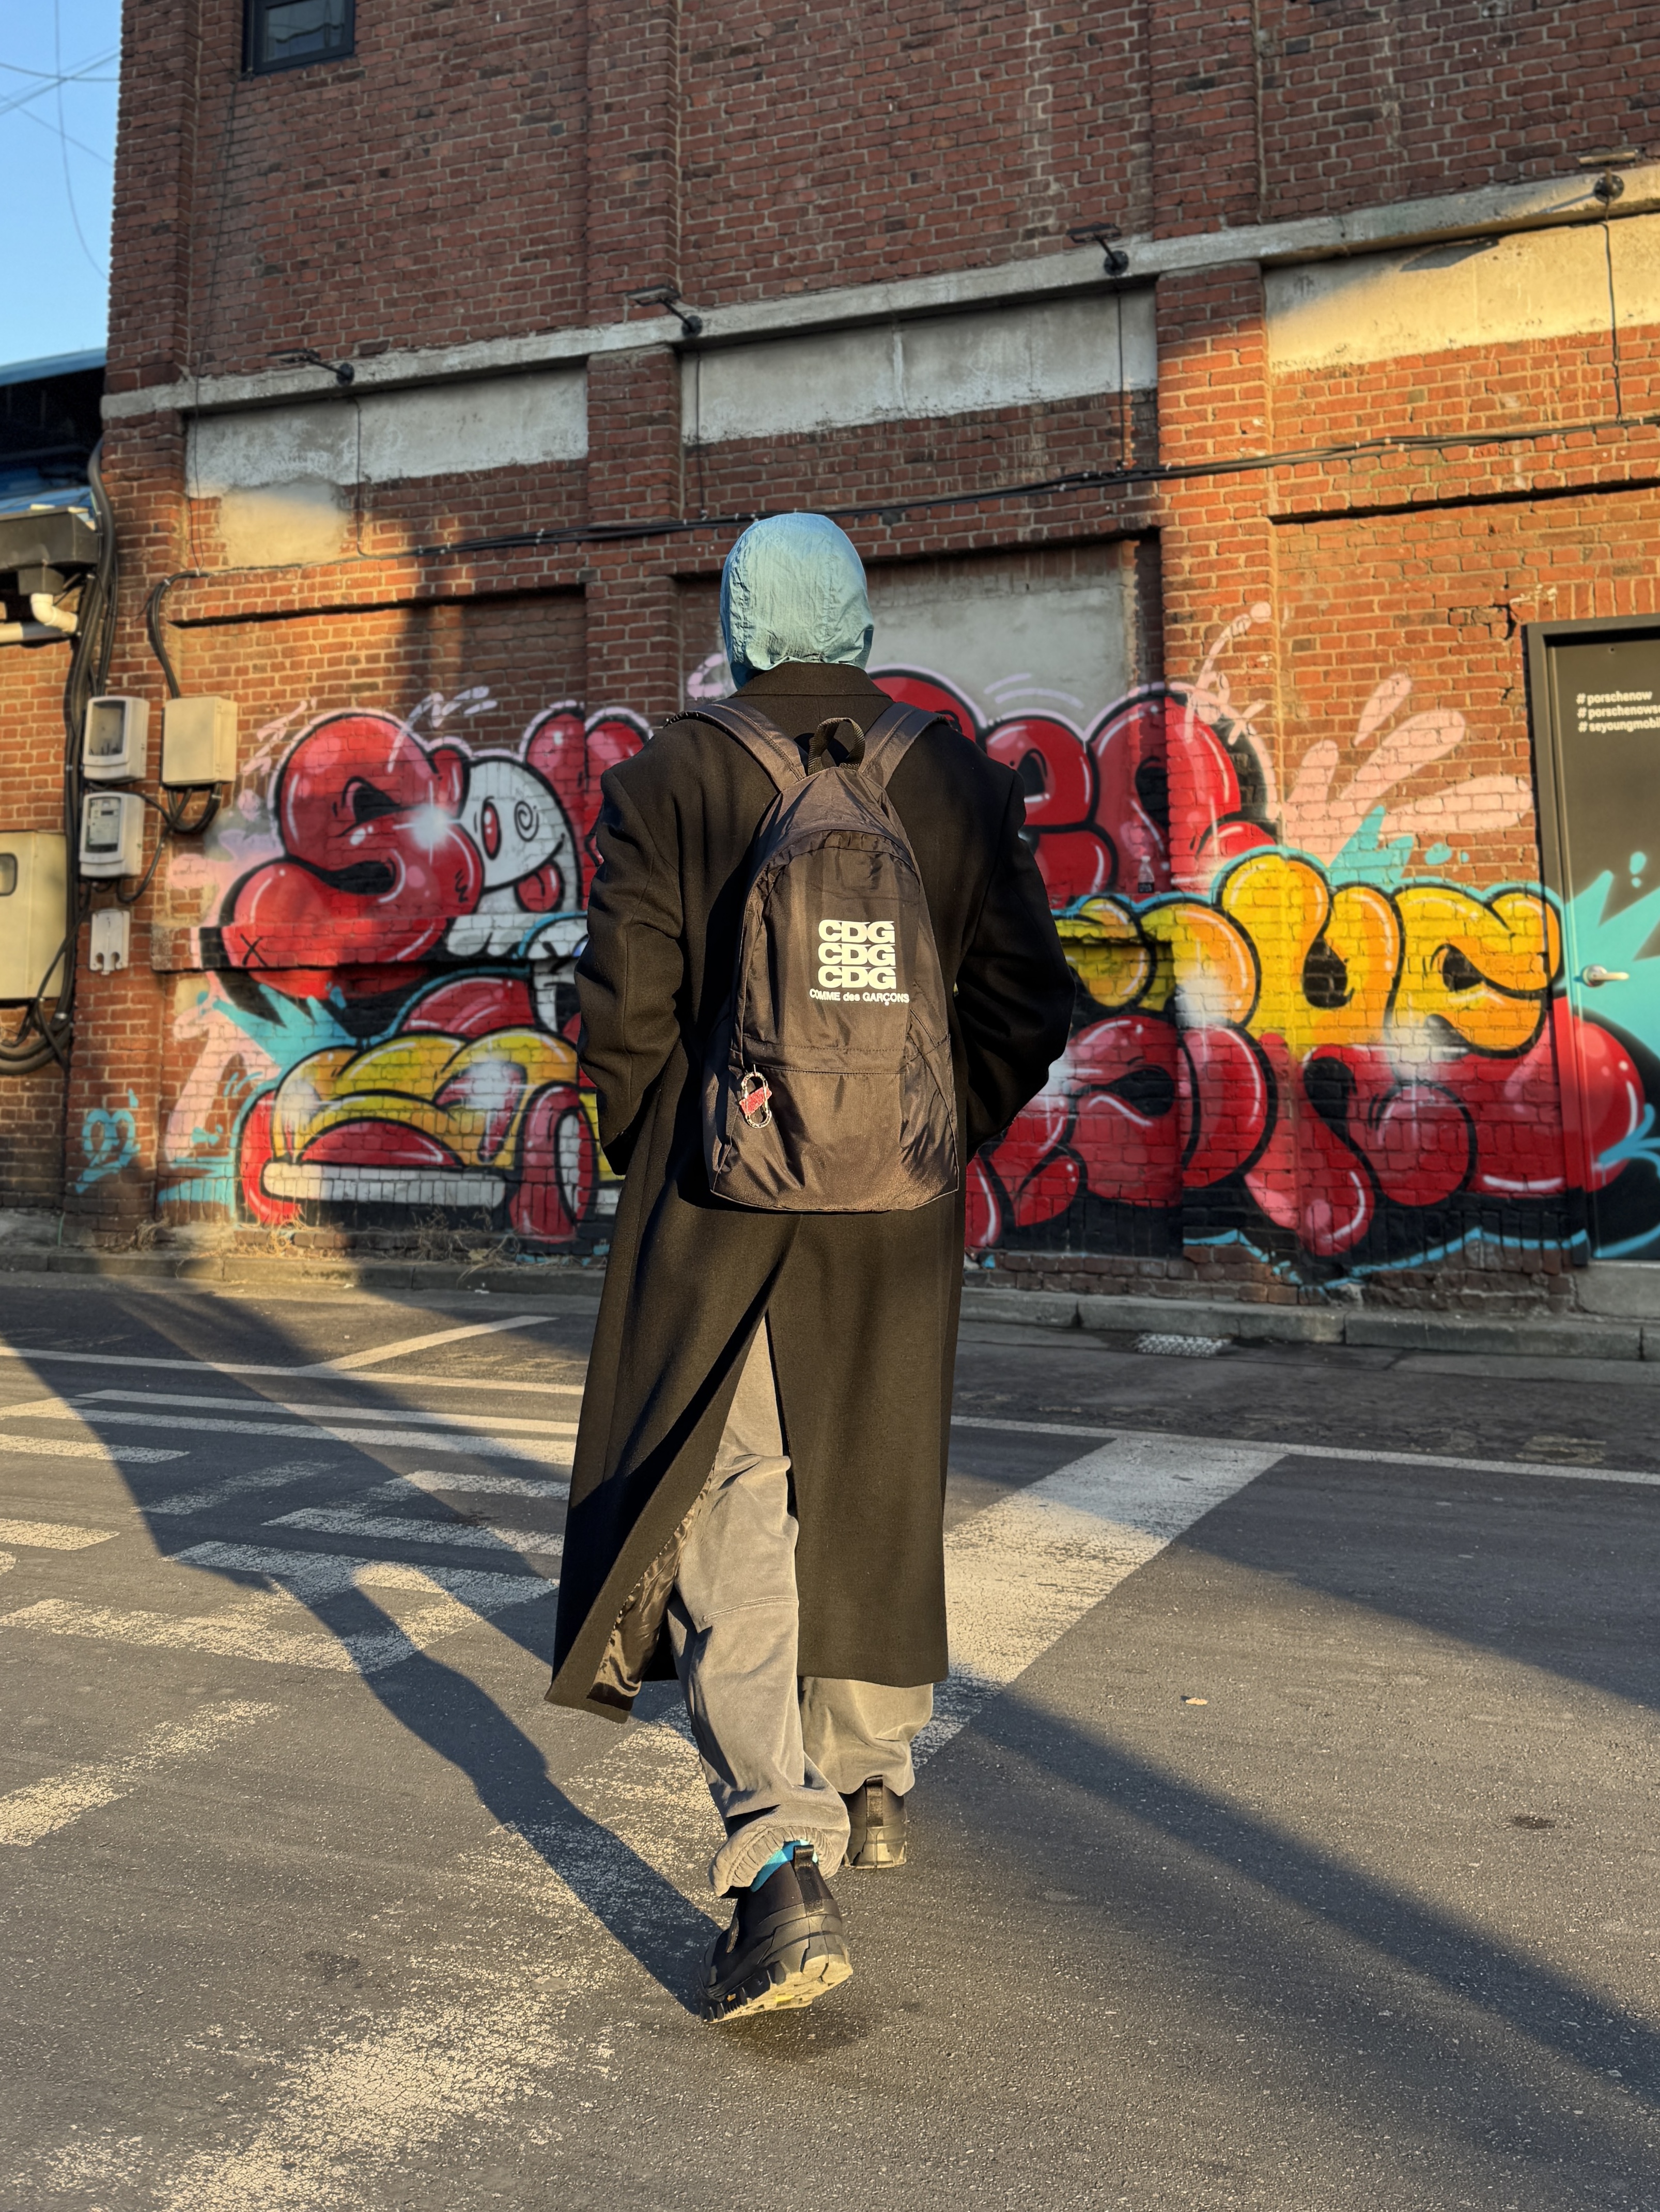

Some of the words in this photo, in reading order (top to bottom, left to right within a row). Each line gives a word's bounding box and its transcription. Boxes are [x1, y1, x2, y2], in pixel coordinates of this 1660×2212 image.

[818, 920, 895, 943] CDG
[818, 942, 896, 966] CDG
[818, 965, 897, 989] CDG
[809, 989, 841, 1001] COMME
[843, 992, 861, 1002] des
[862, 992, 910, 1006] GARÇONS
